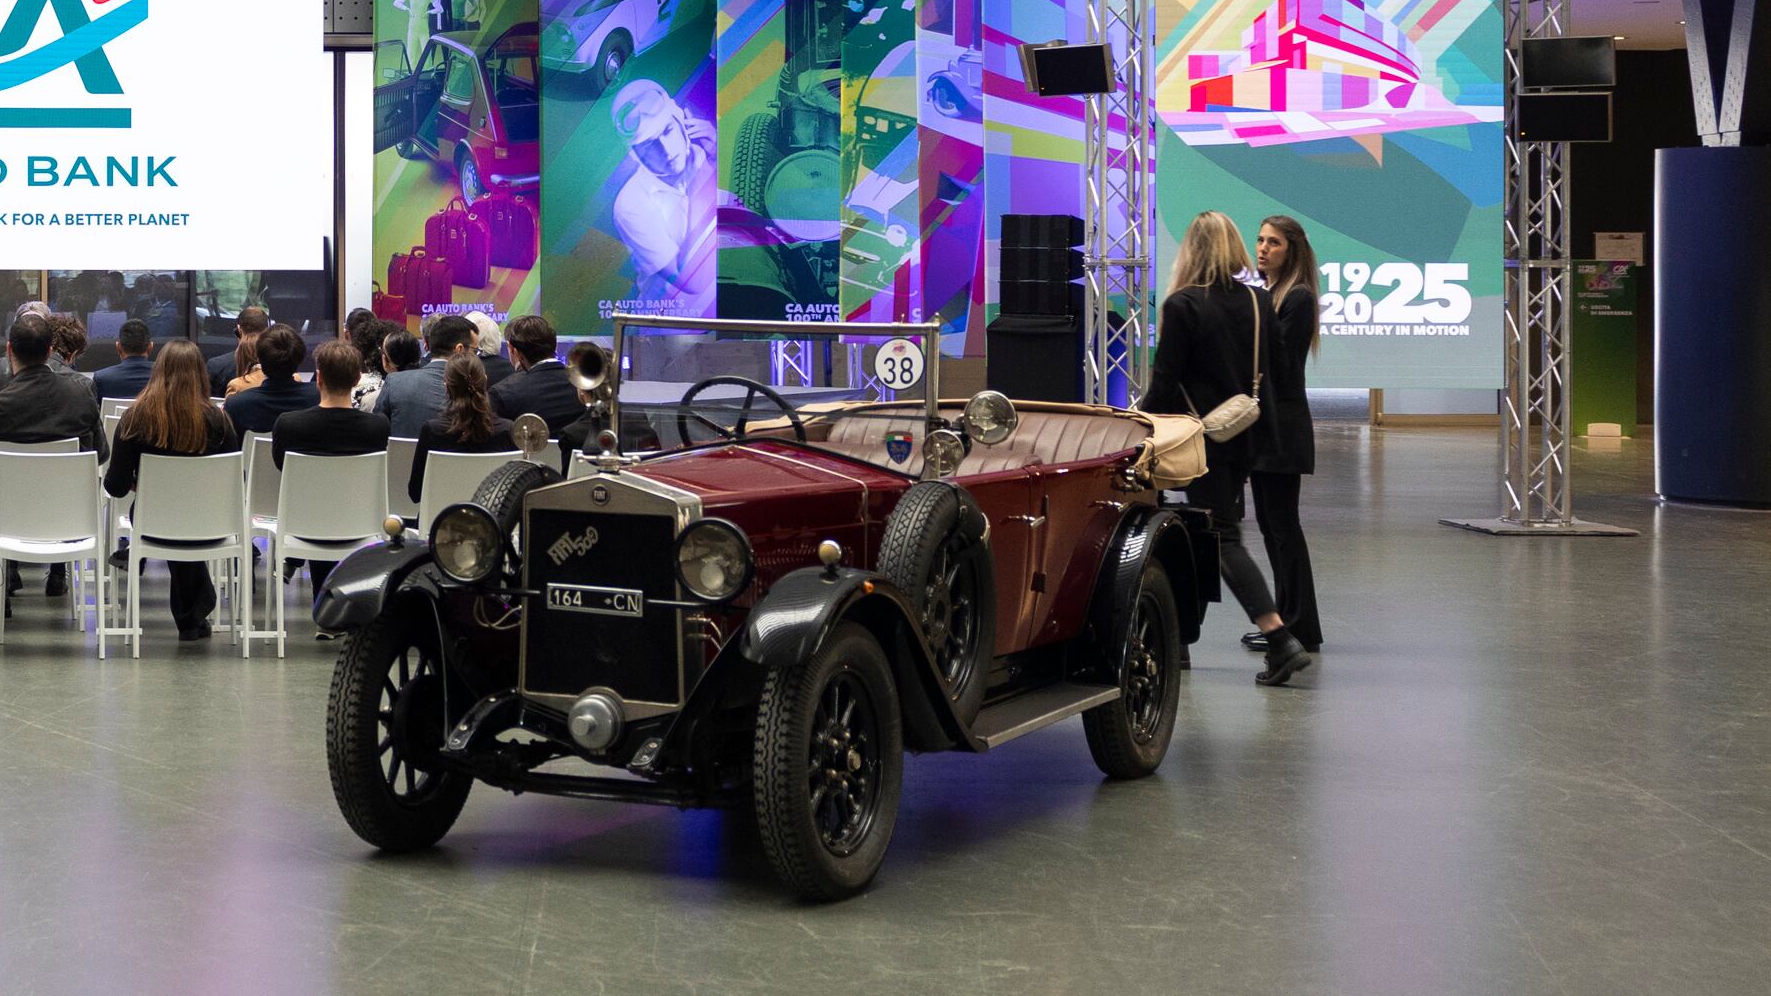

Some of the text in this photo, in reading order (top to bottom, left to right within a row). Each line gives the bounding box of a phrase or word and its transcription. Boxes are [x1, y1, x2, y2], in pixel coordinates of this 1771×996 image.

[27, 155, 178, 187] BANK
[12, 213, 45, 226] FOR
[49, 213, 61, 226] A
[65, 213, 124, 226] BETTER
[128, 213, 190, 226] PLANET
[1319, 262, 1371, 292] 19
[1370, 262, 1472, 324] 25
[422, 303, 434, 313] CA
[436, 303, 460, 313] AUTO
[598, 300, 613, 310] CA
[646, 300, 685, 310] BANK'S
[785, 303, 803, 313] CA
[1319, 292, 1372, 324] 20
[1319, 324, 1470, 336] A CENTURY IN MOTION
[883, 357, 914, 385] 38
[554, 590, 639, 612] 164 CN
